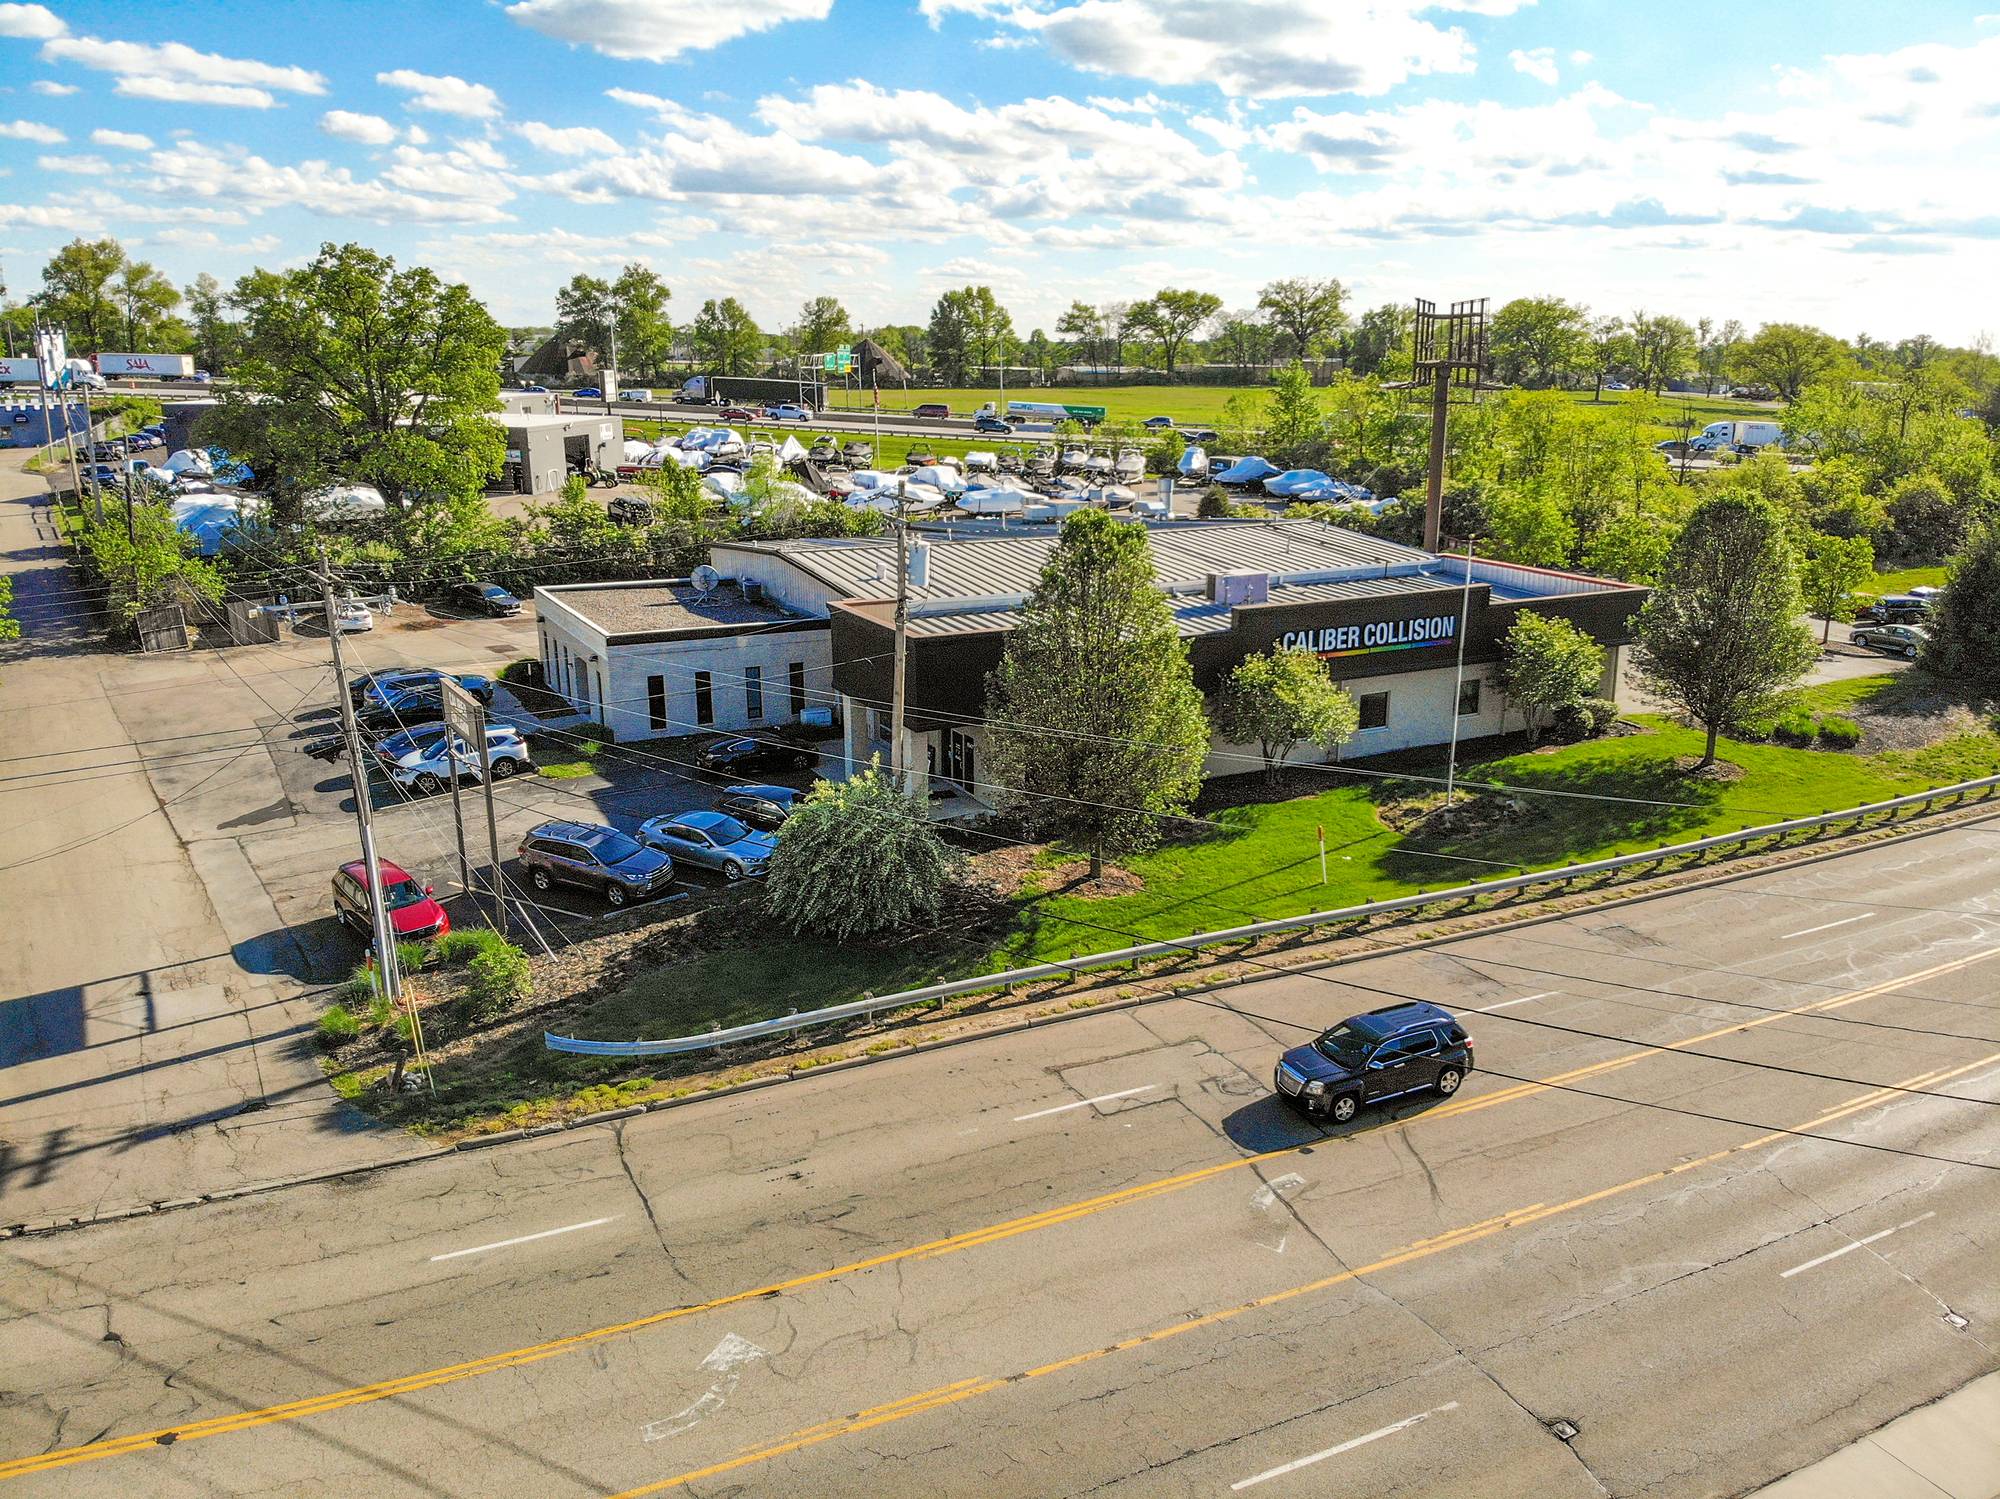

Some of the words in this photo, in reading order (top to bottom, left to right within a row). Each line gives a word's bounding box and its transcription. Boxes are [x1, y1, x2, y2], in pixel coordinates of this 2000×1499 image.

[126, 358, 154, 371] SAIA
[1283, 626, 1360, 654] CALIBER
[1364, 616, 1454, 646] COLLISION
